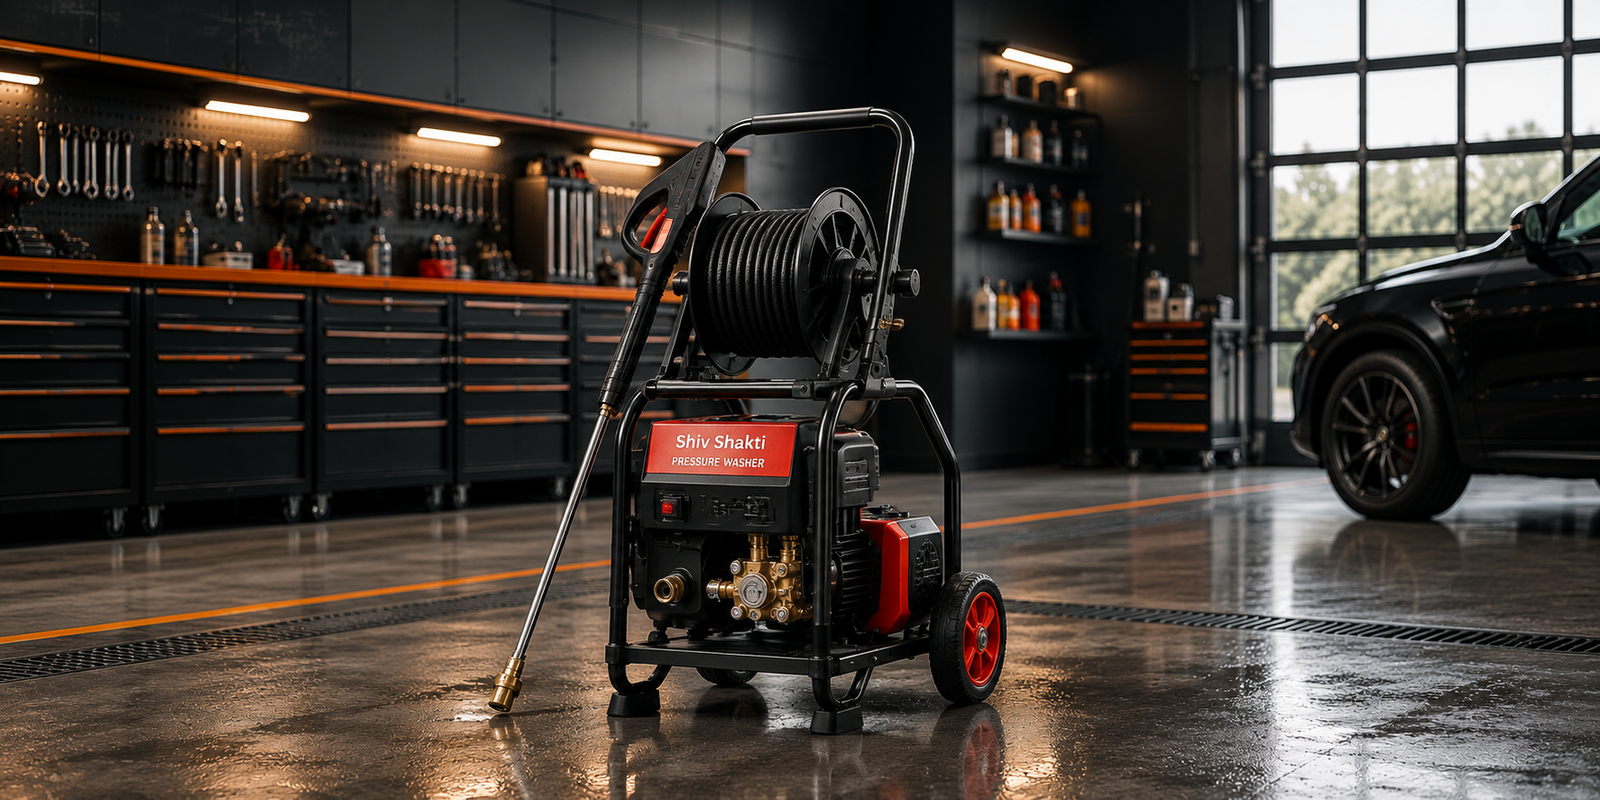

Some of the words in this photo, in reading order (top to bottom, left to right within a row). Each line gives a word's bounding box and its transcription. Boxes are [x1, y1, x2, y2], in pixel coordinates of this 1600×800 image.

[675, 434, 711, 449] Shiv
[713, 434, 767, 450] Shakti
[671, 456, 721, 467] PRESSURE
[723, 457, 765, 468] WASHER
